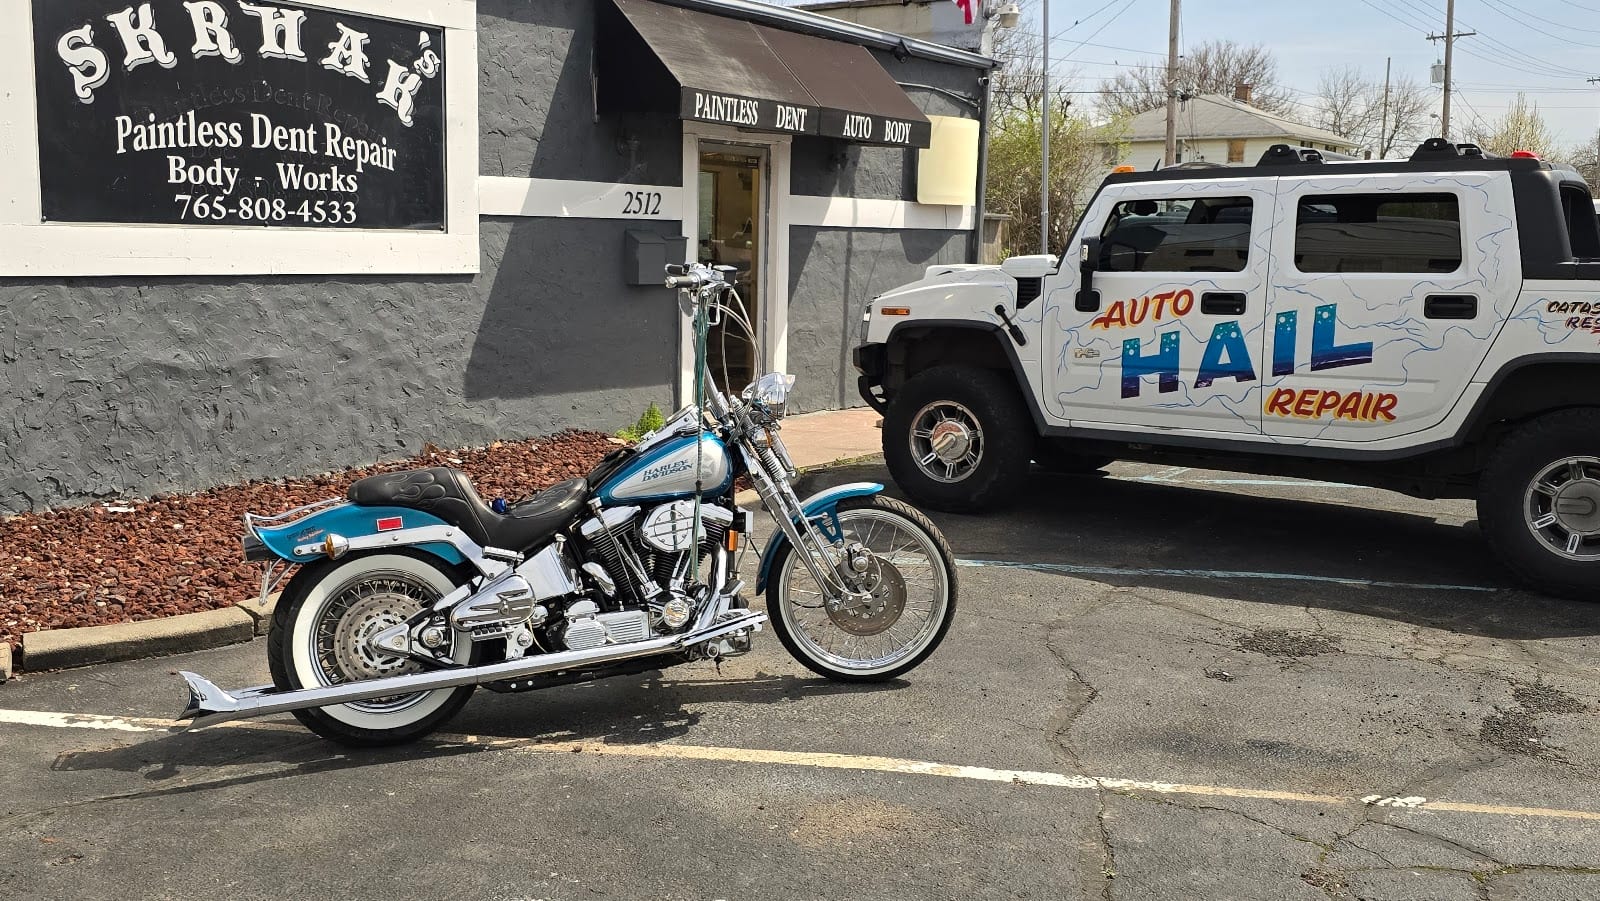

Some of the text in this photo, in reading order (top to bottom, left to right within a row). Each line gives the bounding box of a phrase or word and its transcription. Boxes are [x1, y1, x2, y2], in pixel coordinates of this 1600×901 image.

[694, 92, 808, 131] PAINTLESS DENT
[842, 114, 912, 144] AUTO BODY
[115, 109, 243, 154] Paintless
[250, 113, 317, 154] Dent
[325, 123, 397, 173] Repair
[167, 155, 240, 195] Body
[276, 163, 359, 193] Works
[174, 194, 358, 224] 765-808-4533
[622, 191, 662, 216] 2512
[1090, 288, 1195, 331] AUTO
[1120, 303, 1374, 399] HAIL
[1264, 386, 1399, 423] REPAIR
[643, 459, 688, 475] HARLEY
